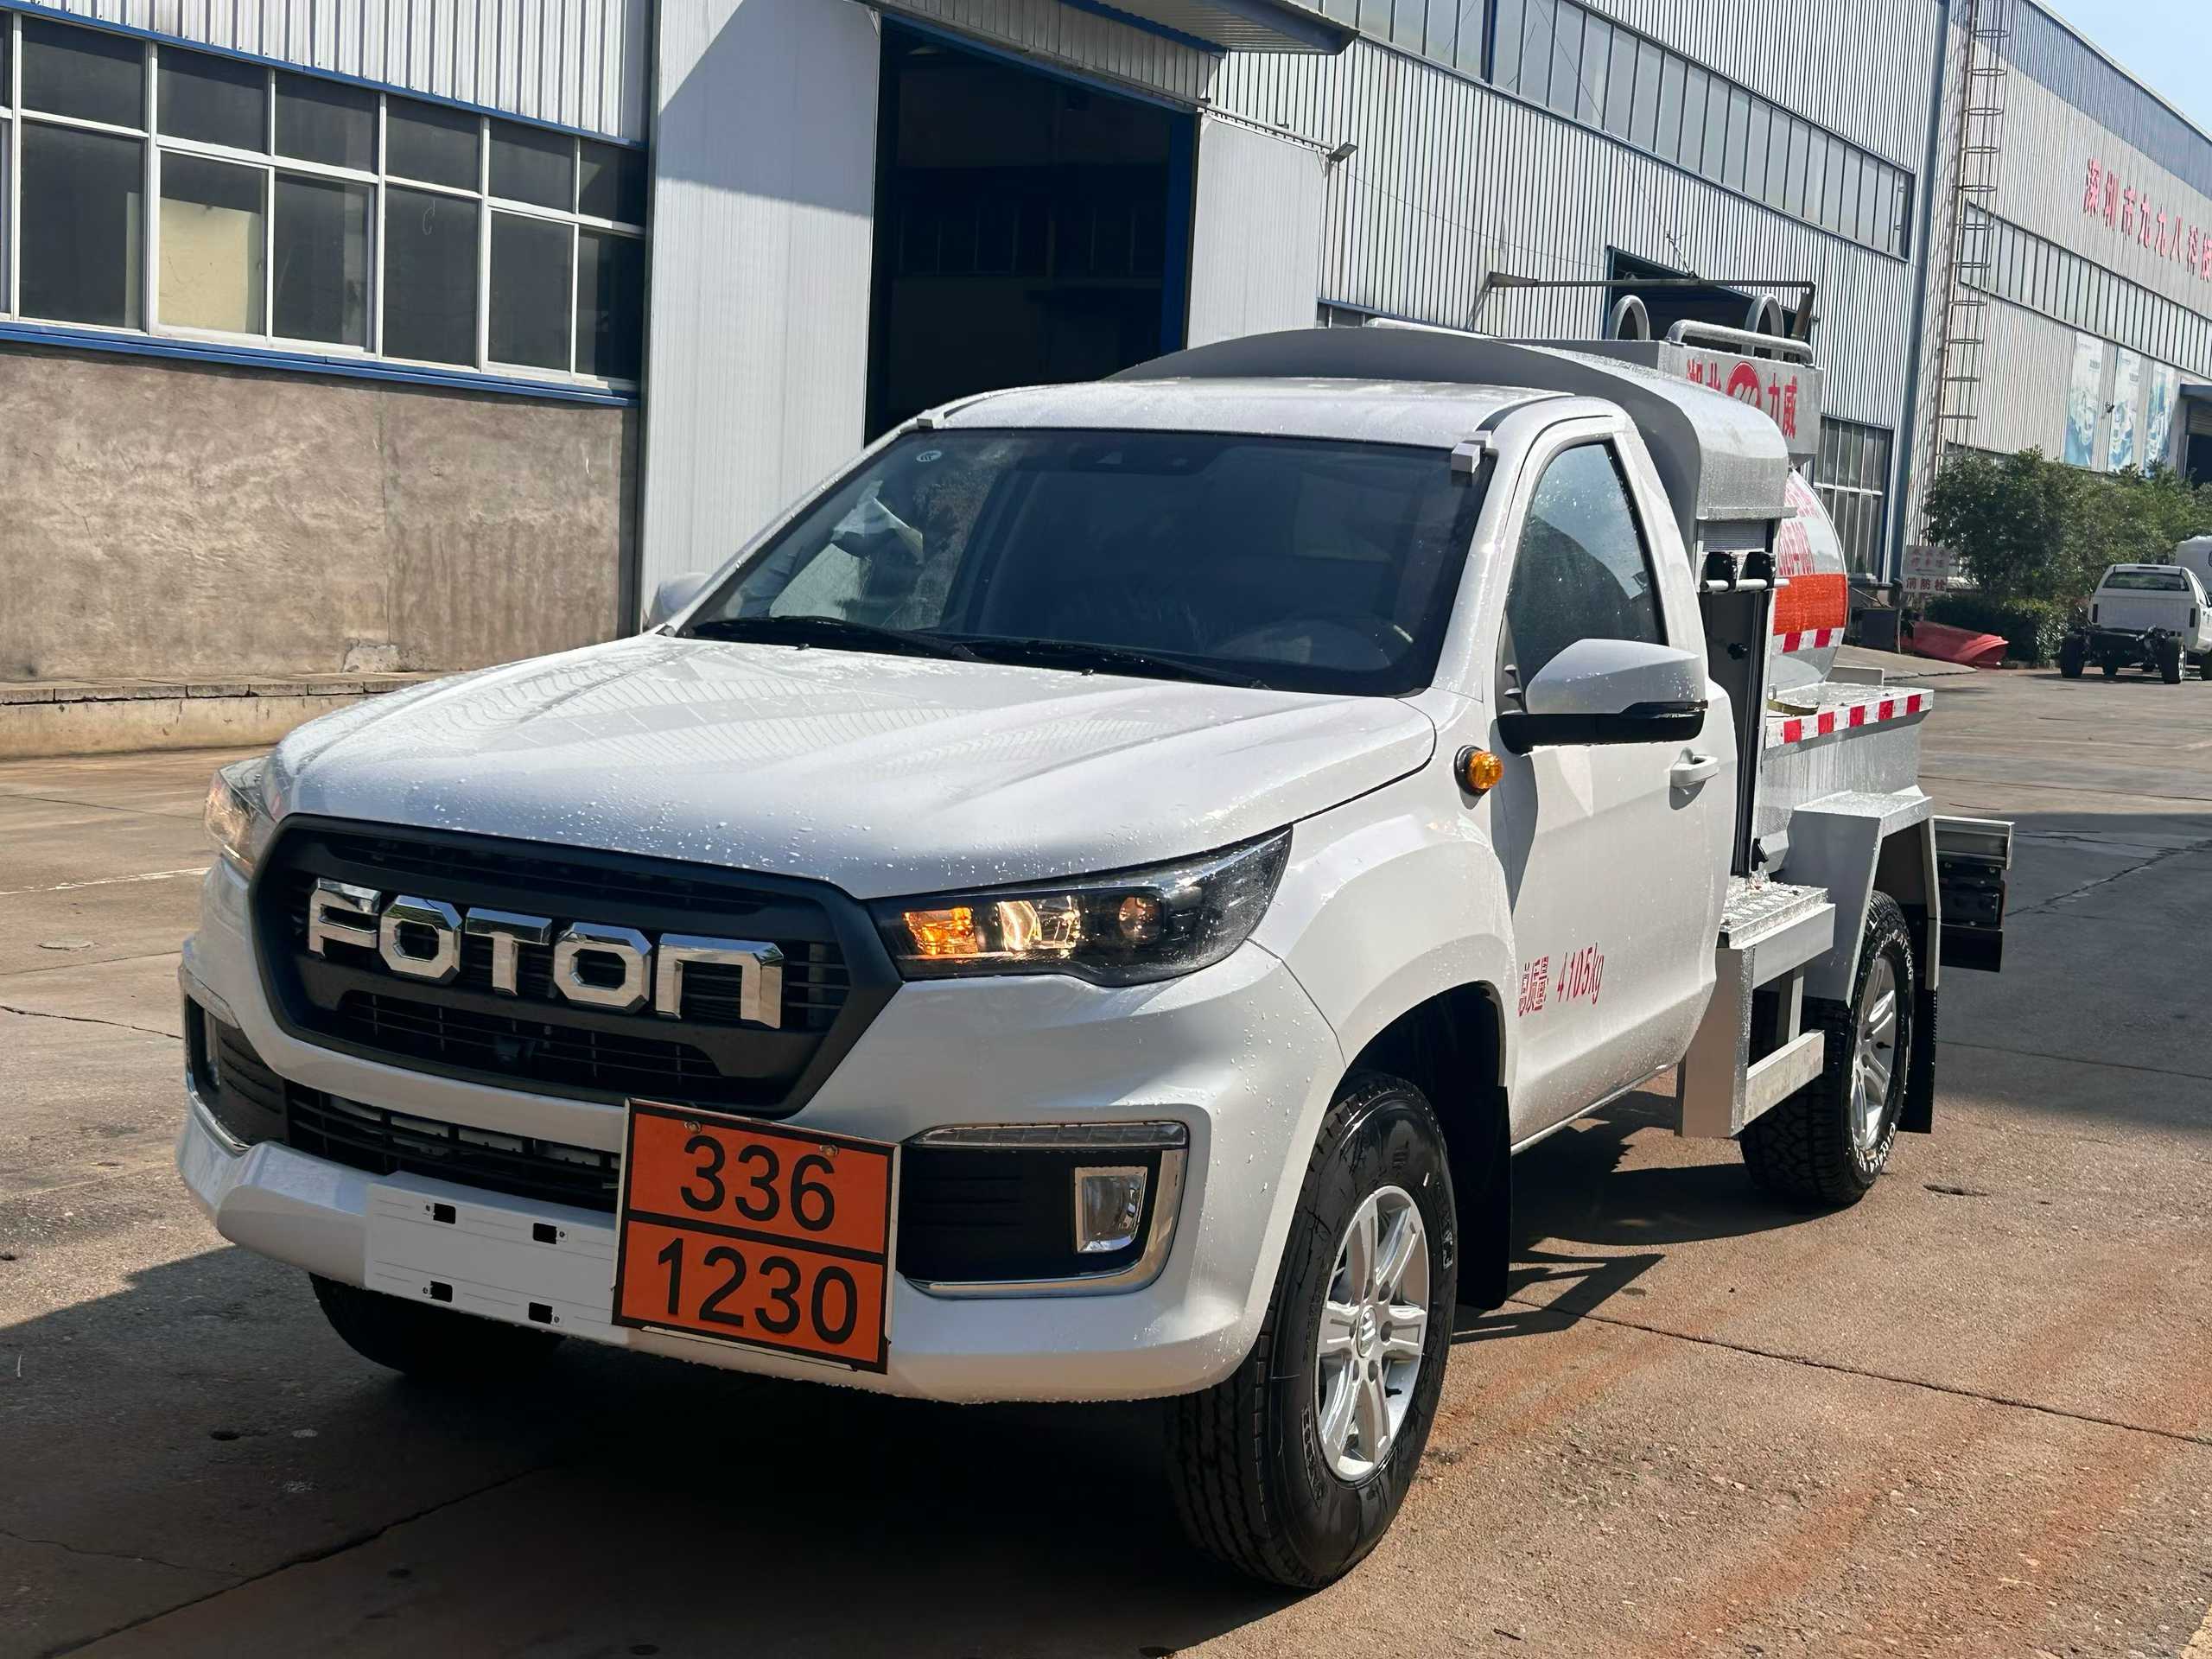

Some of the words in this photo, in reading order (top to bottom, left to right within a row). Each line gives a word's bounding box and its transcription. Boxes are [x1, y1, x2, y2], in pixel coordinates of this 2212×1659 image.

[308, 877, 784, 1029] FOTON
[1518, 956, 1549, 1017] 总质量
[1557, 941, 1605, 1005] 4105kg
[680, 1135, 836, 1232] 336
[658, 1237, 858, 1344] 1230
